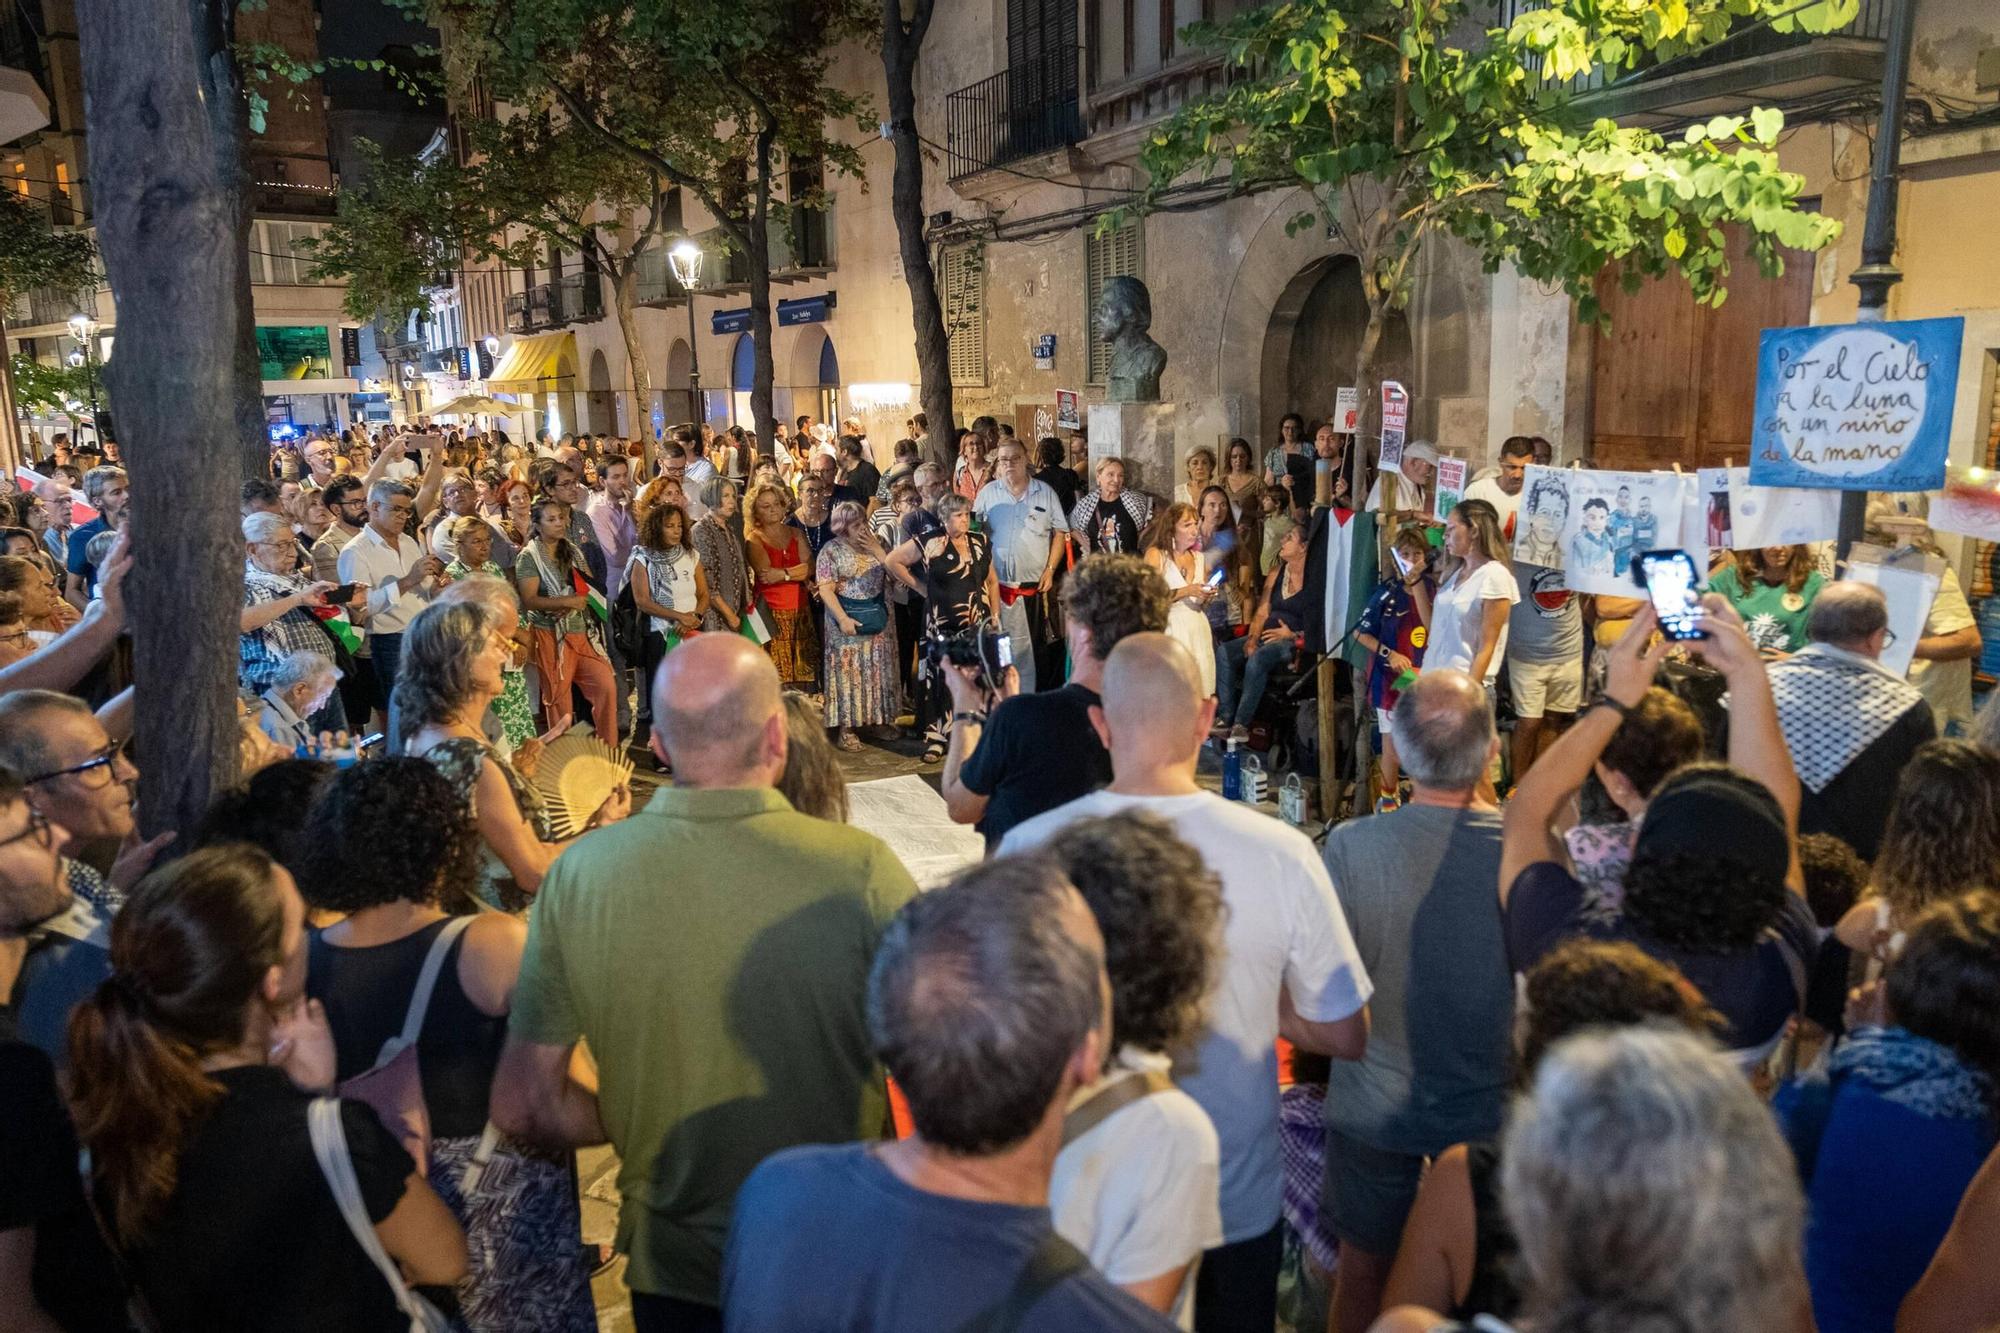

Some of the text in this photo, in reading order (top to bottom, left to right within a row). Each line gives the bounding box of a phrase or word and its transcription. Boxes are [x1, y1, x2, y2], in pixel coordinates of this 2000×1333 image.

[347, 329, 356, 359] GALLERY
[459, 349, 467, 374] GALLERY
[1778, 343, 1931, 384] Por el Cielo
[1808, 384, 1837, 411] la
[1843, 382, 1919, 411] luna
[1762, 412, 1914, 435] con un niño
[1761, 437, 1903, 463] de la mano
